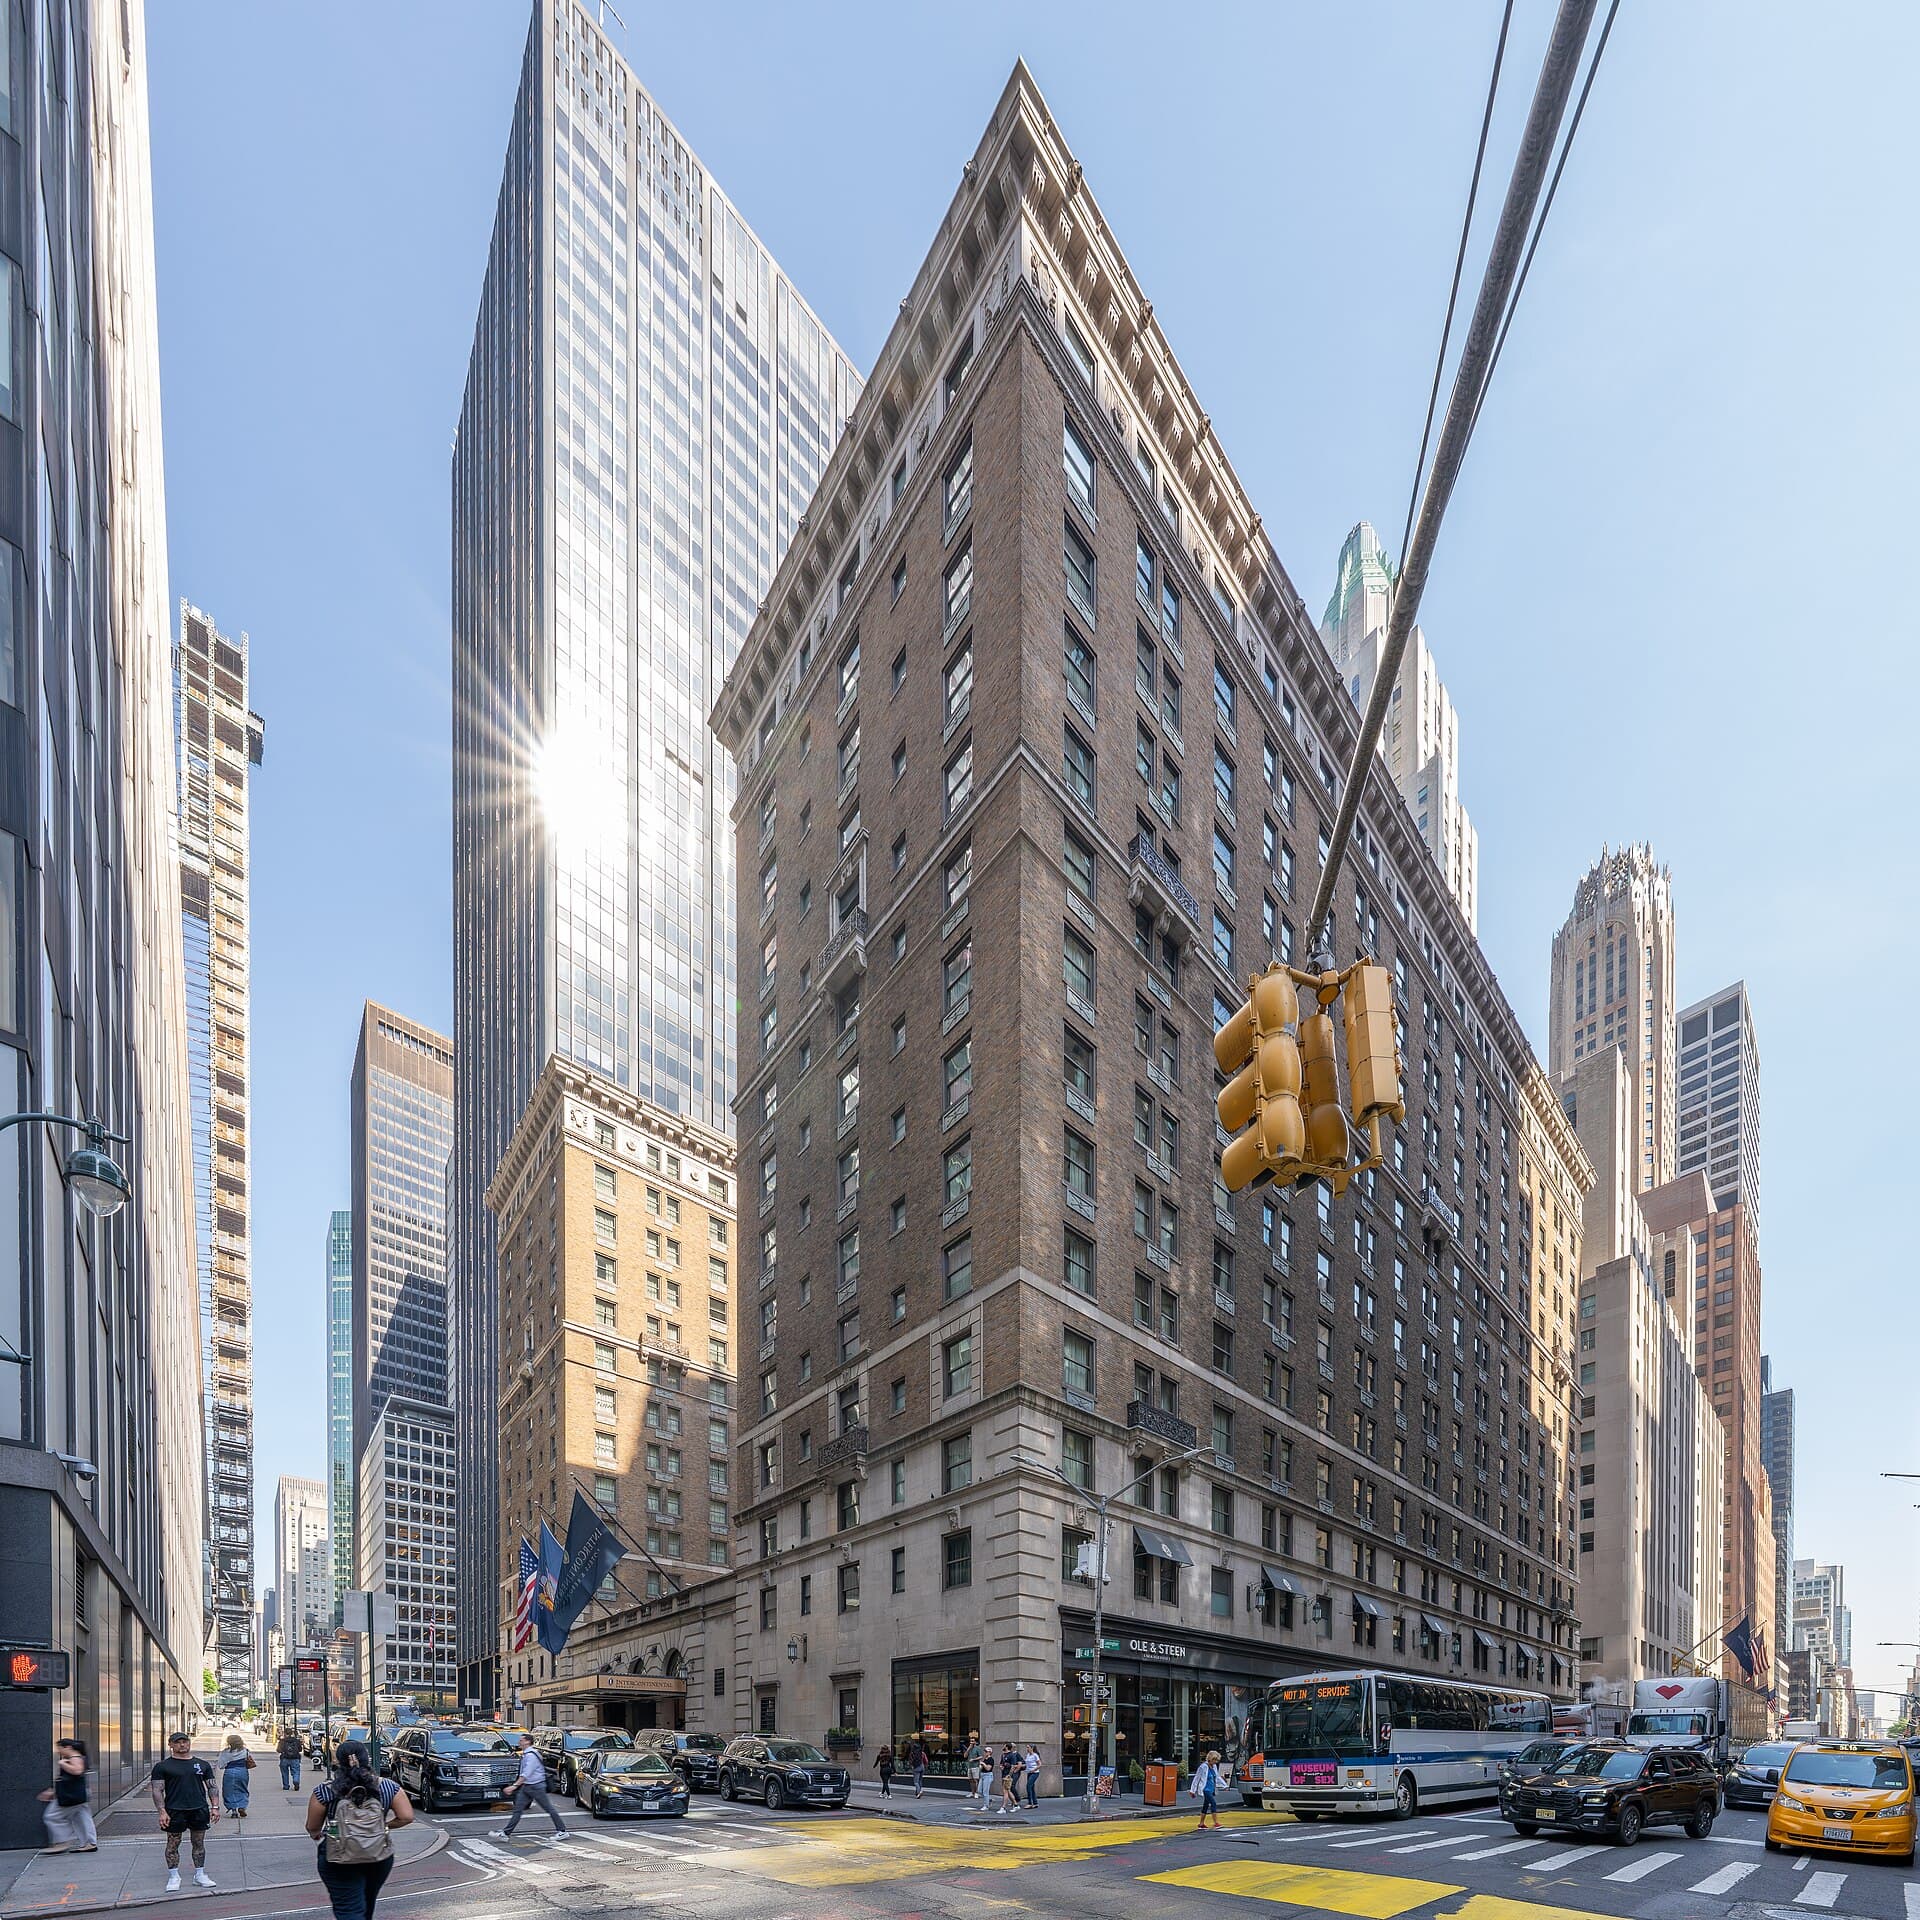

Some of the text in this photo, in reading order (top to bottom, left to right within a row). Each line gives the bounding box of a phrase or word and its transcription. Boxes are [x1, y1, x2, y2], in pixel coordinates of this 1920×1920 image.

[1130, 1640, 1148, 1652] OLE
[1150, 1643, 1157, 1653] &
[1158, 1645, 1186, 1657] STEEN
[1284, 1686, 1350, 1700] NOT IN SERVICE
[1292, 1763, 1335, 1773] MUSEUM
[1293, 1775, 1335, 1784] OF SEX
